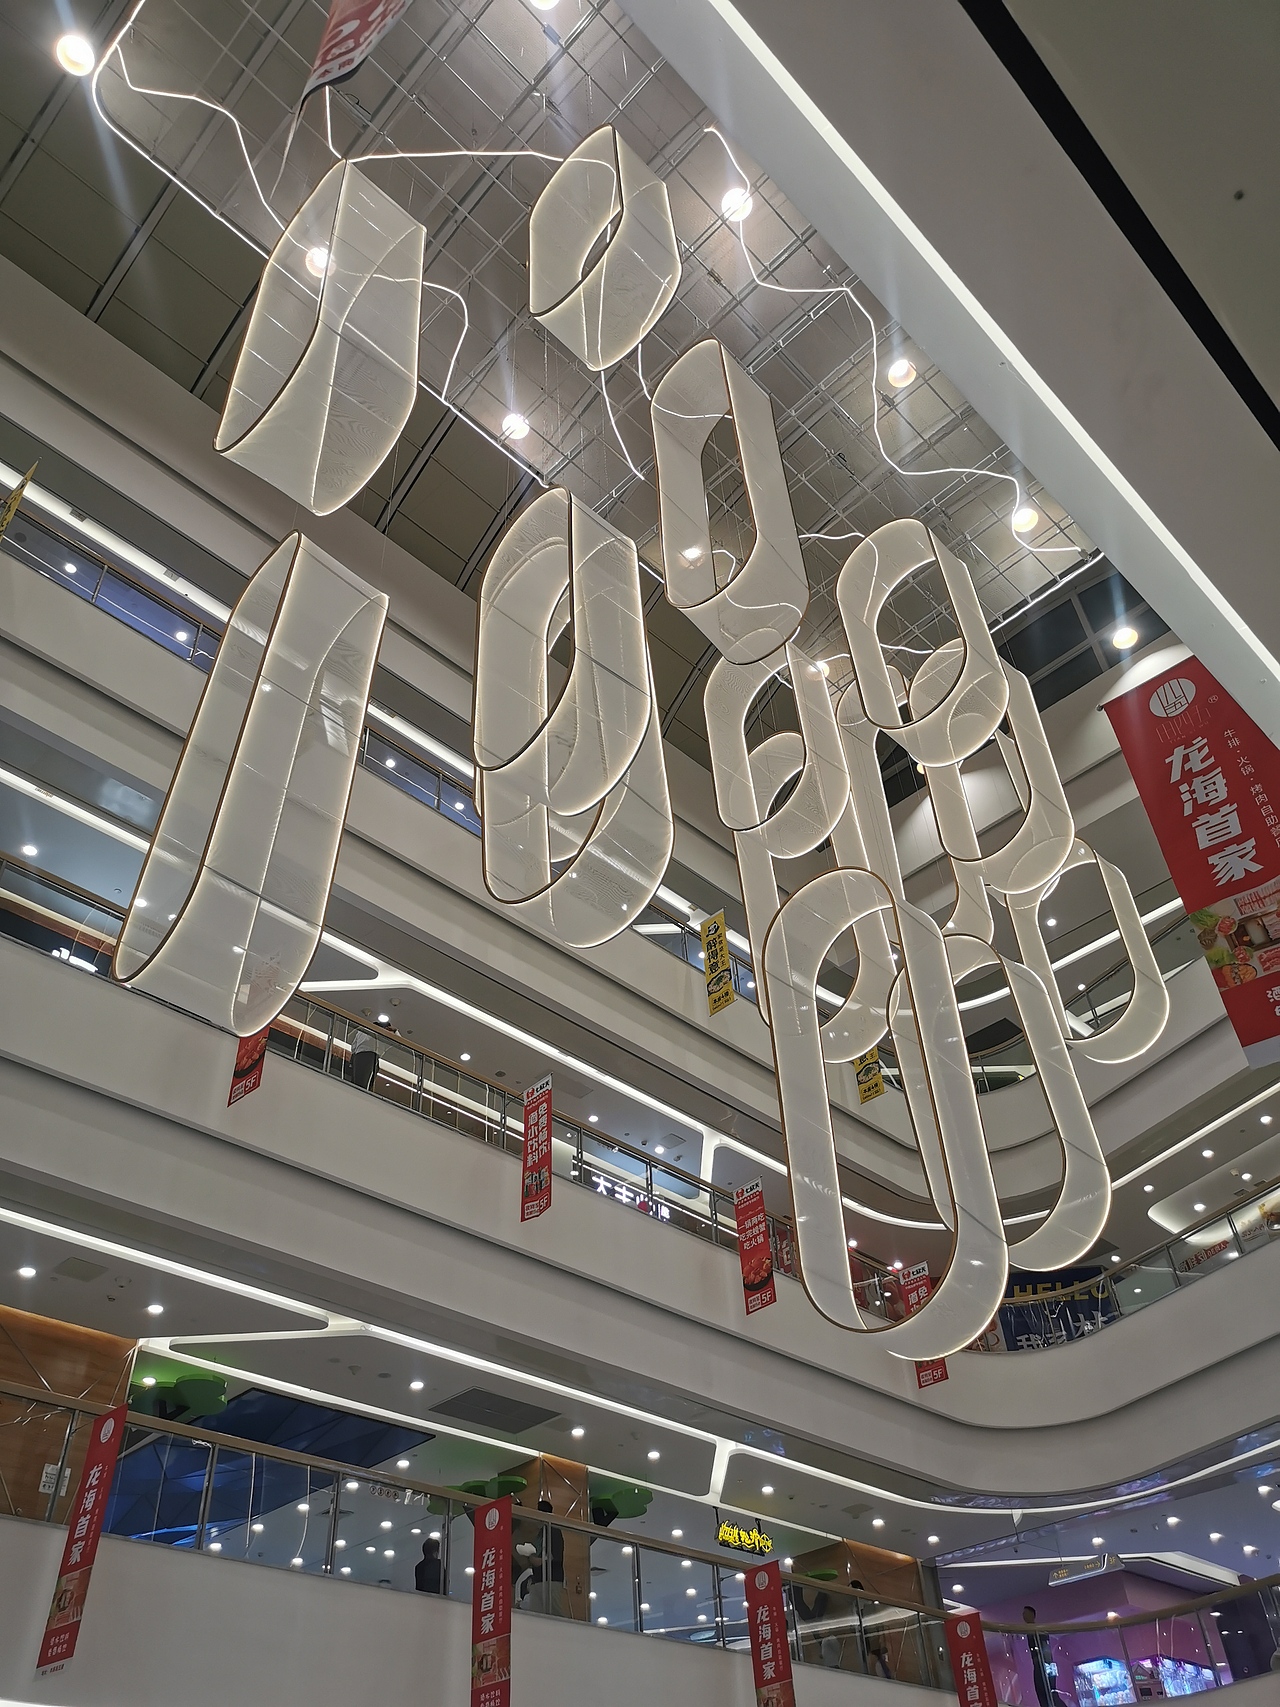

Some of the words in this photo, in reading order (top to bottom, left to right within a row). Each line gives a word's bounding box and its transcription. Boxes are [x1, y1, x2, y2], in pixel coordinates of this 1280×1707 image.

[1165, 736, 1265, 887] 龙海首家
[245, 1074, 257, 1091] 5F
[539, 1195, 549, 1212] 5F
[761, 1291, 772, 1304] 5F
[933, 1368, 943, 1380] 5F
[67, 1463, 103, 1566] 龙海首家
[480, 1547, 496, 1635] 龙海首家
[756, 1604, 777, 1680] 龙海首家
[960, 1651, 984, 1707] 龙海首
